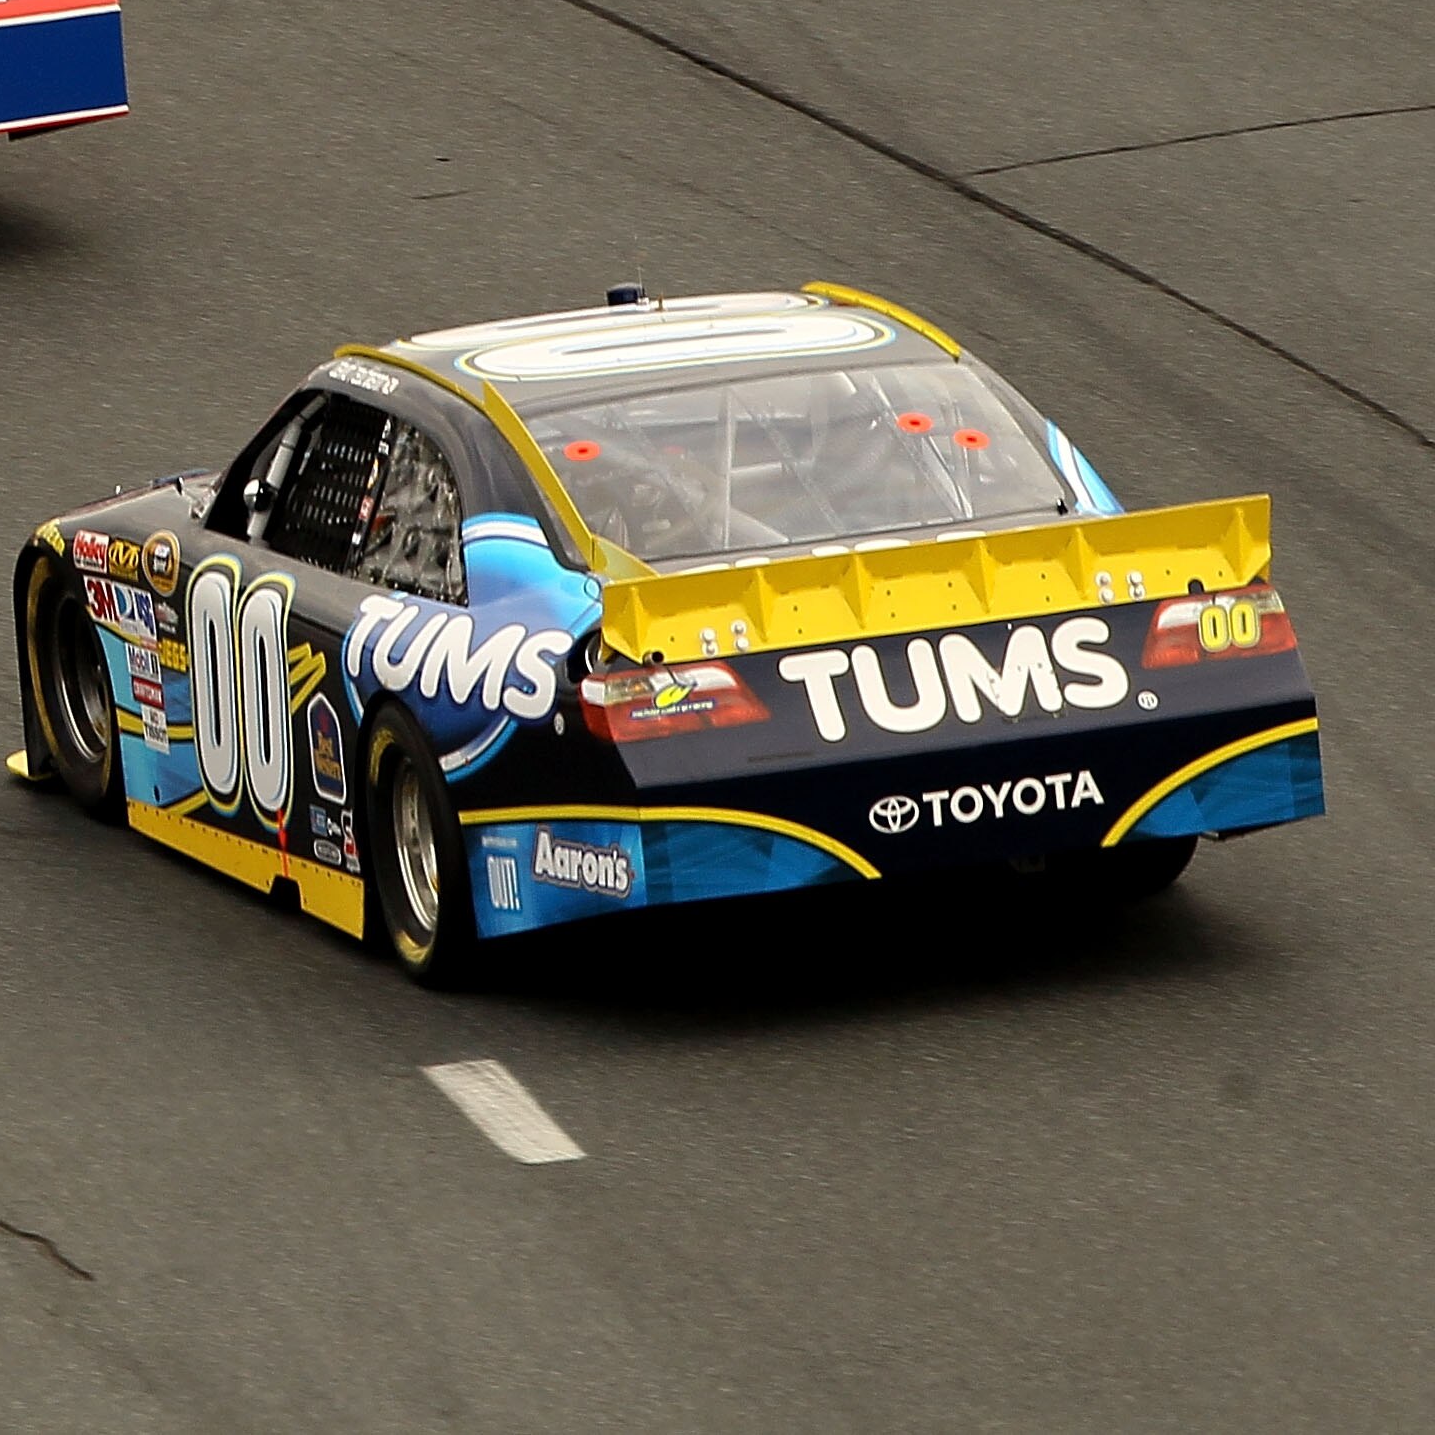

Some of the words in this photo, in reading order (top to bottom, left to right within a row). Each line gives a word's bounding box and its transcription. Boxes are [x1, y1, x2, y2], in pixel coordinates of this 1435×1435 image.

[86, 579, 121, 624] 3M
[1197, 599, 1261, 653] 00
[347, 594, 574, 719] TUMS
[778, 616, 1131, 742] TUMS
[188, 558, 293, 824] 00
[922, 770, 1106, 827] TOYOTA
[534, 829, 630, 893] Aaron's
